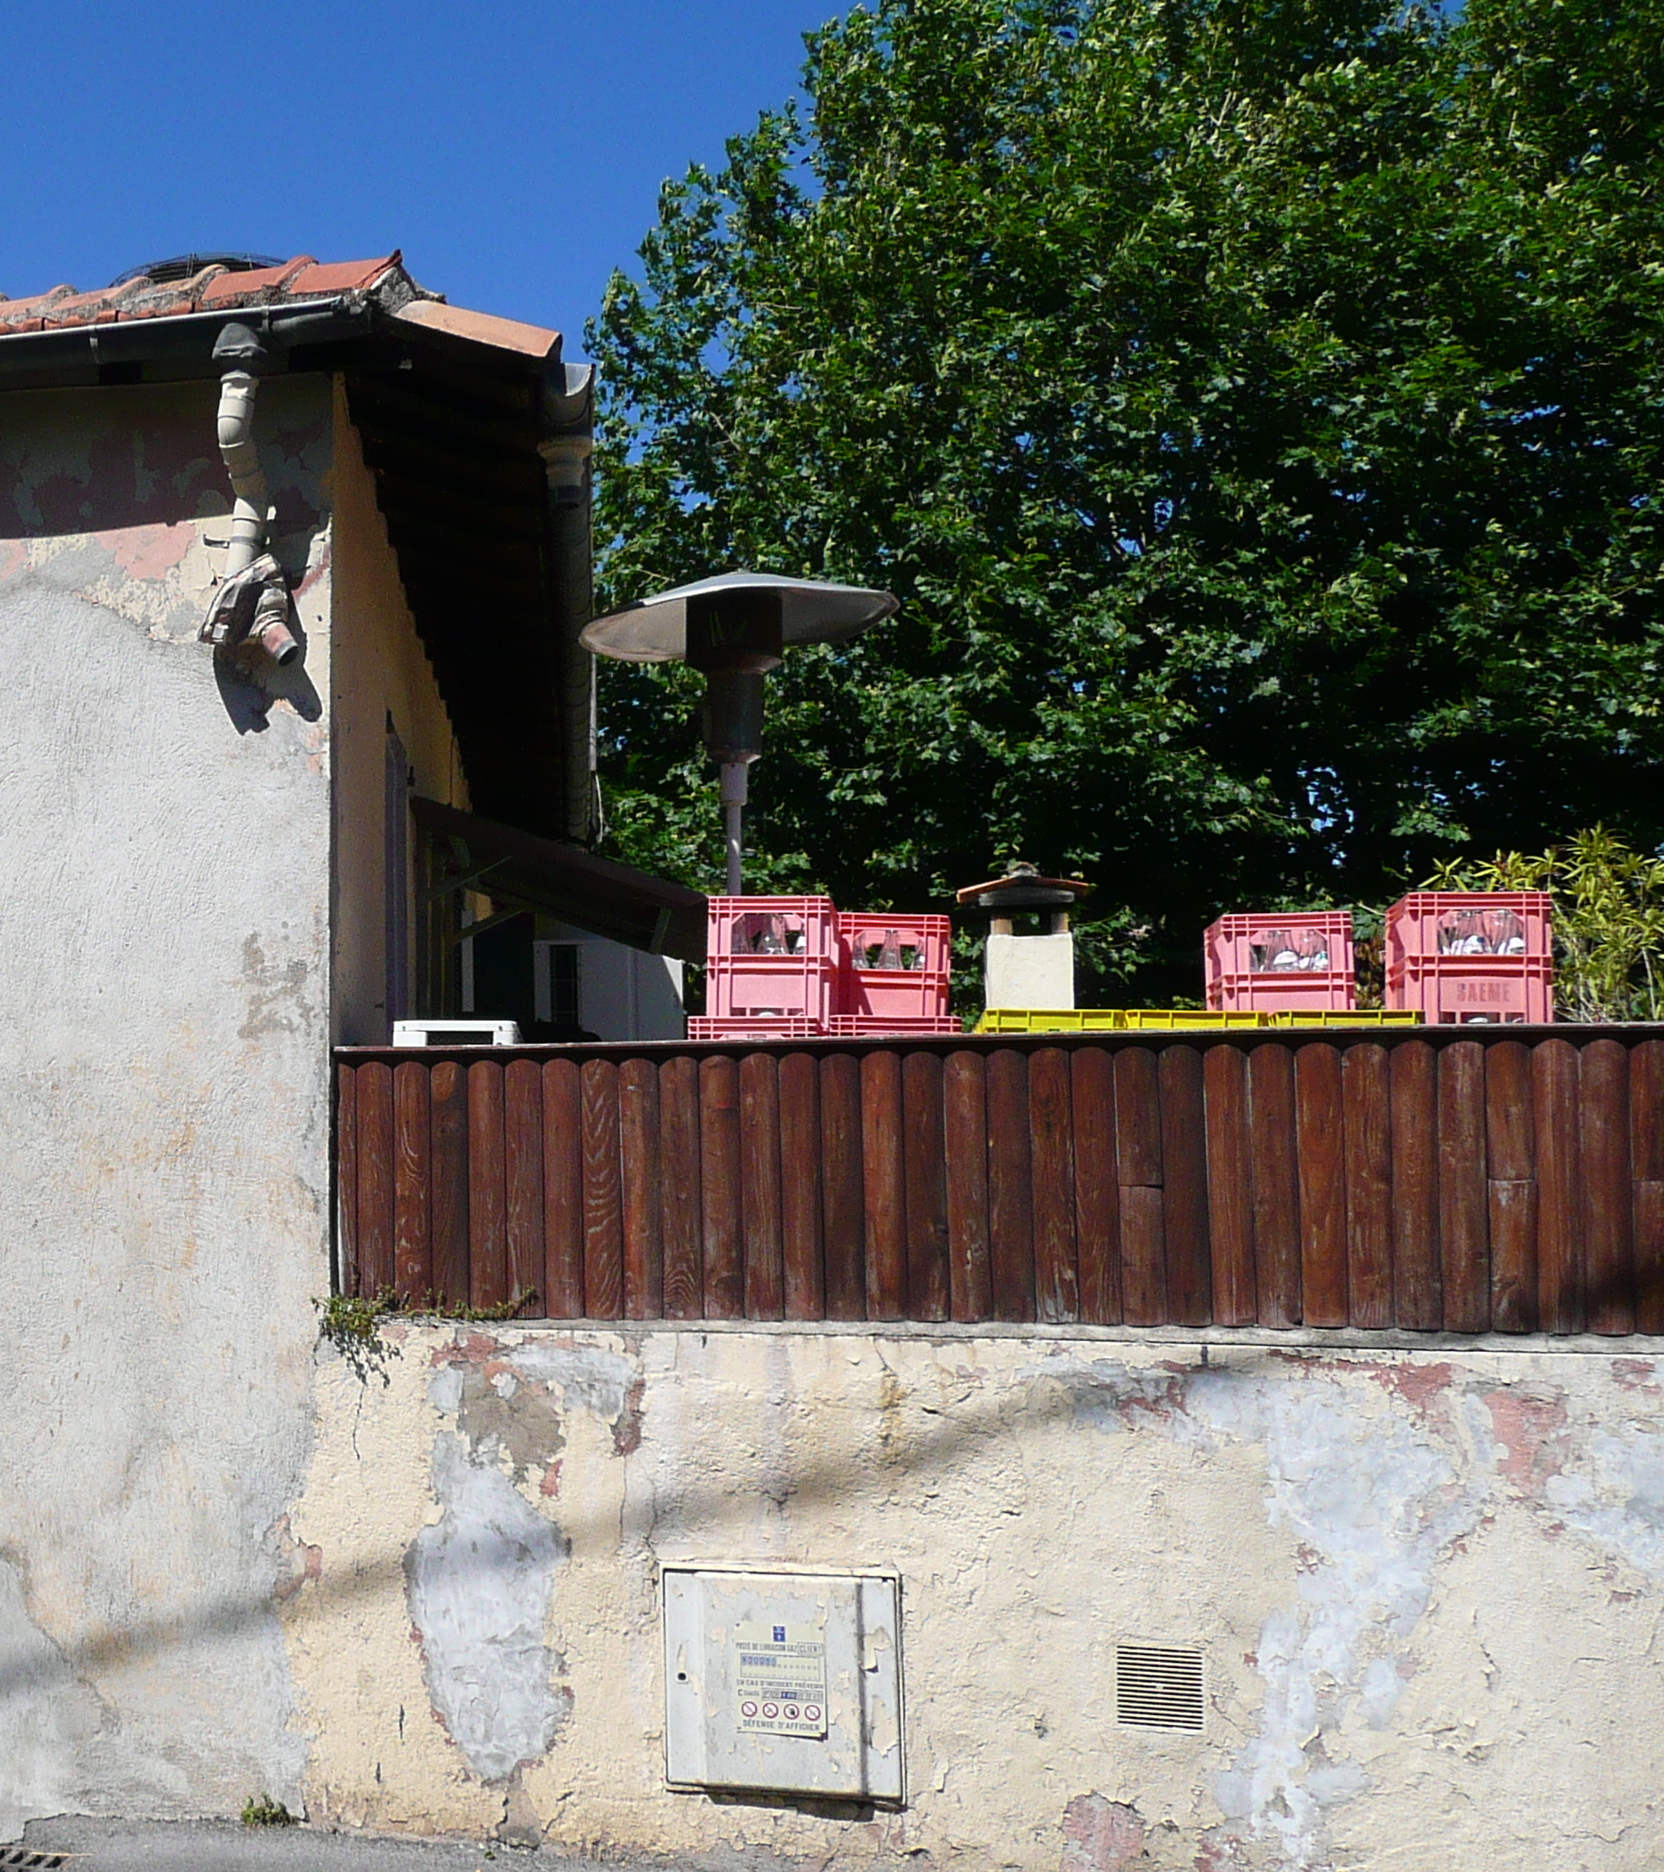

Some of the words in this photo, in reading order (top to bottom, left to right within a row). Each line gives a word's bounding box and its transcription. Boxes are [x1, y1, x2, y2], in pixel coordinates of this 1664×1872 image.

[1458, 983, 1510, 1002] SAEME
[742, 1718, 775, 1728] DÉFENSE
[778, 1721, 820, 1731] D'AFFICHER
